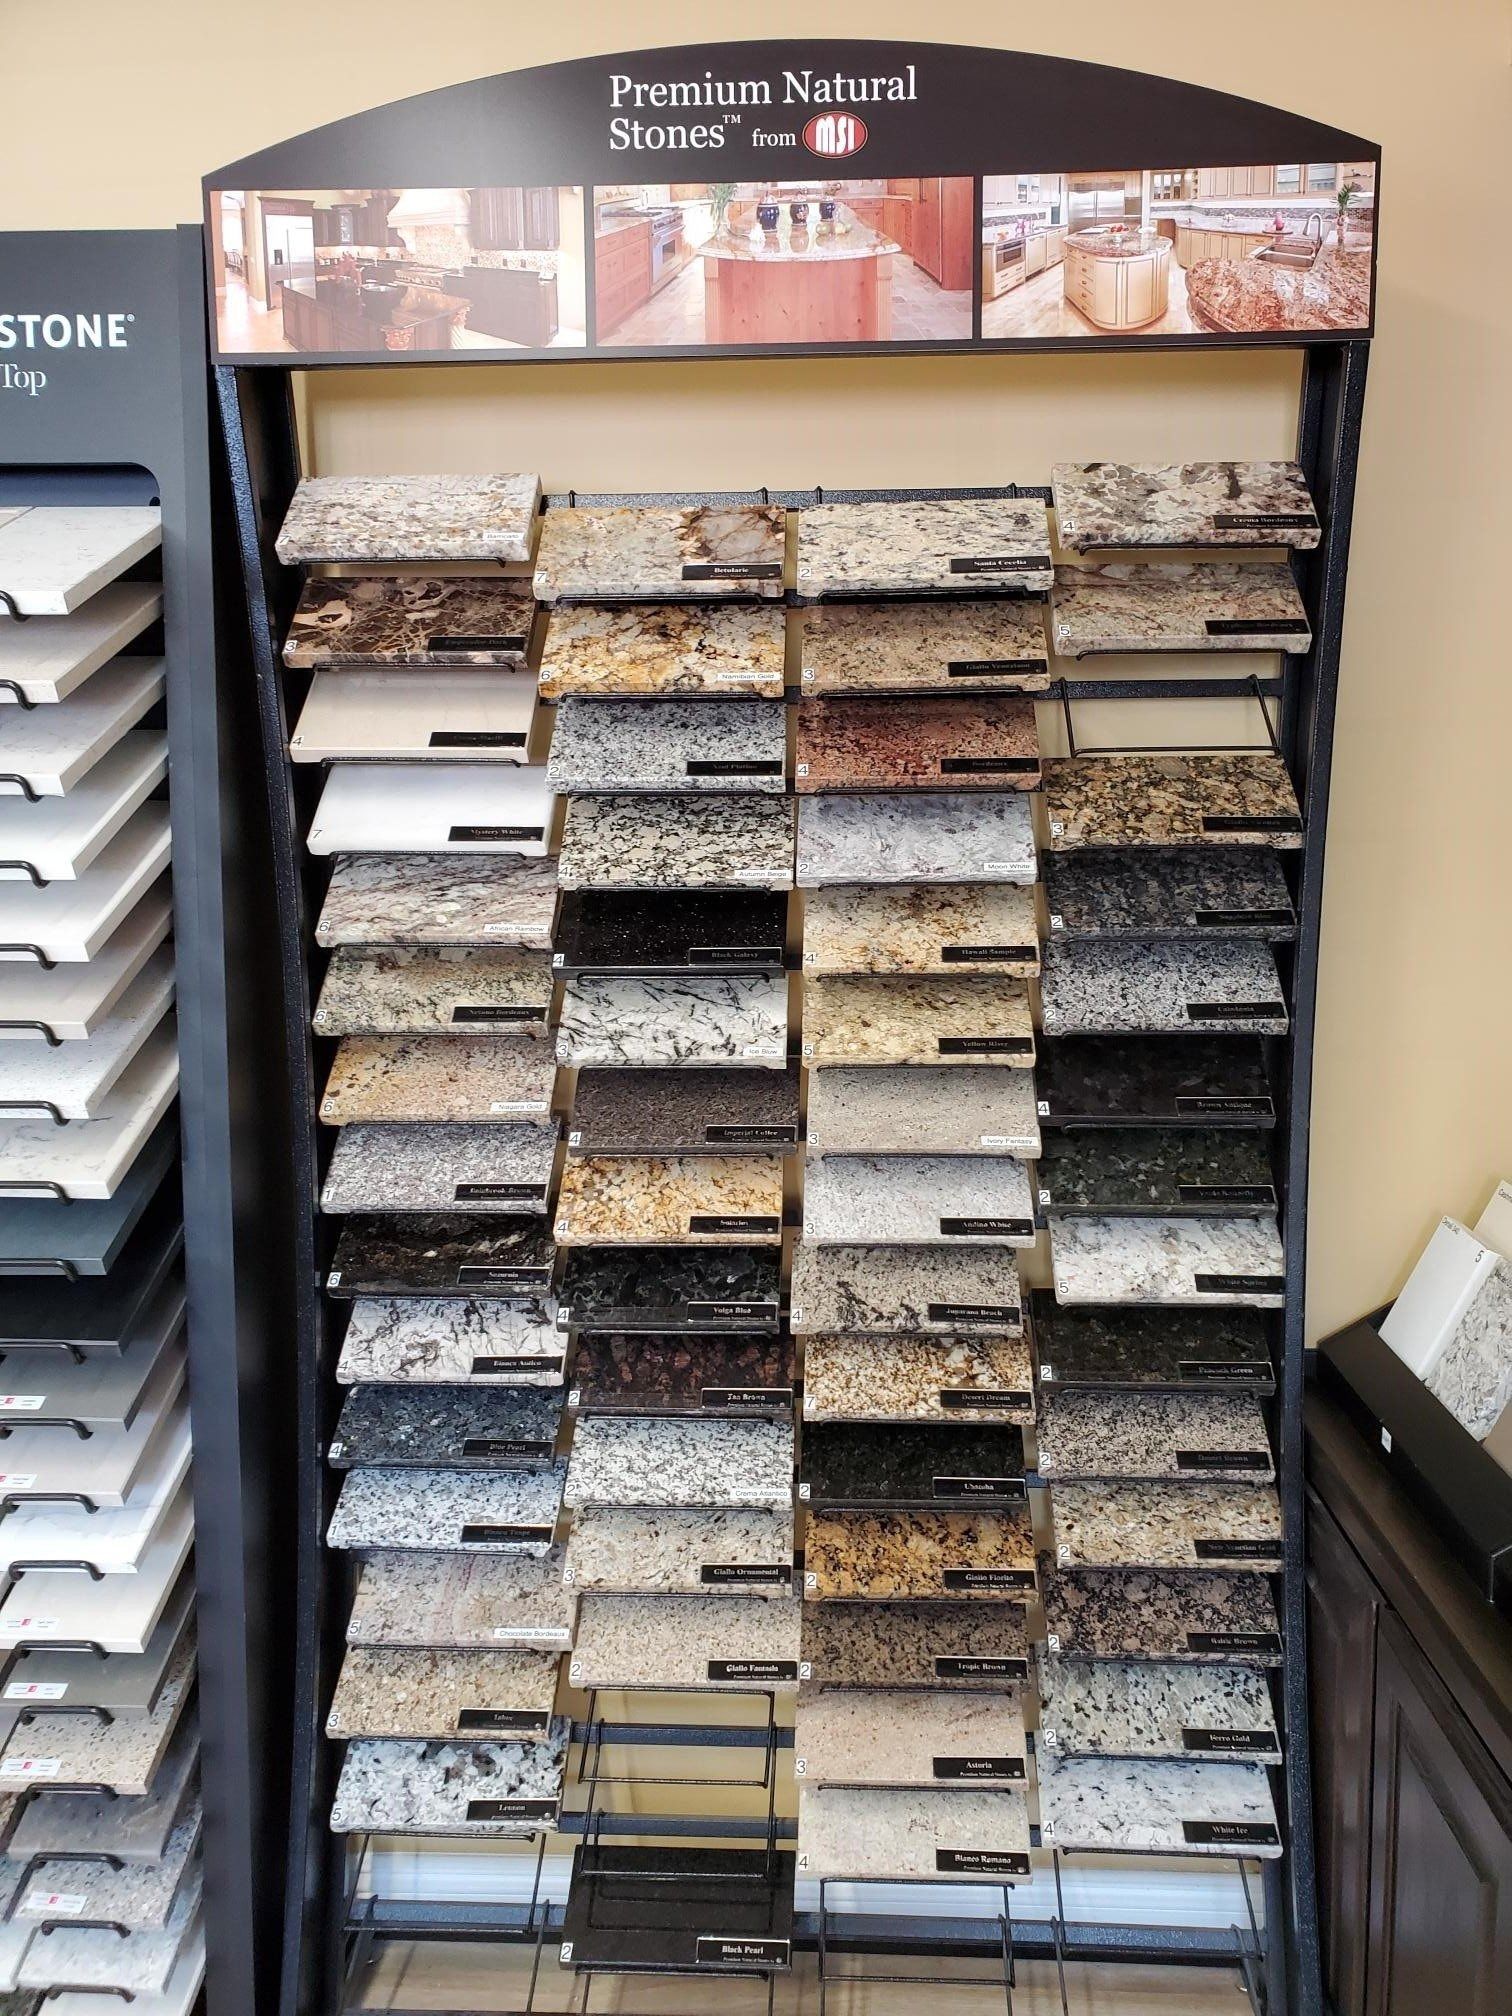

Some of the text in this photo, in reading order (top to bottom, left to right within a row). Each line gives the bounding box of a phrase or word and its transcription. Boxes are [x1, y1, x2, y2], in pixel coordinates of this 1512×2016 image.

[609, 65, 918, 107] Premium Natural
[751, 128, 797, 148] from
[815, 115, 855, 154] MSI
[0, 363, 47, 396] Top
[1063, 521, 1074, 530] 4
[278, 536, 288, 545] 7
[536, 572, 546, 581] 7
[800, 569, 810, 578] 2
[1059, 626, 1070, 635] 5
[285, 641, 295, 652] 3
[540, 670, 551, 680] 6
[803, 670, 814, 680] 3
[292, 736, 303, 746] 4
[549, 766, 560, 776] 2
[798, 765, 808, 775] 4
[311, 830, 322, 839] 7
[1053, 824, 1063, 834] 3
[560, 866, 569, 876] 4
[799, 864, 809, 874] 2
[319, 922, 329, 932] 6
[1052, 917, 1062, 927] 2
[553, 955, 563, 965] 4
[804, 954, 815, 963] 4
[315, 1011, 325, 1021] 6
[1046, 1010, 1055, 1021] 2
[557, 1044, 567, 1055] 3
[804, 1045, 813, 1055] 5
[323, 1102, 333, 1112] 6
[1038, 1103, 1048, 1113] 4
[569, 1134, 580, 1144] 4
[809, 1134, 818, 1144] 3
[987, 1137, 1004, 1145] Ivory
[1039, 1192, 1050, 1203] 2
[557, 1223, 567, 1234] 4
[806, 1223, 815, 1234] 3
[1475, 1250, 1485, 1263] 5
[329, 1274, 339, 1285] 6
[1059, 1282, 1069, 1293] 5
[557, 1310, 568, 1321] 4
[713, 1307, 734, 1315] Volga
[792, 1310, 802, 1321] 4
[338, 1361, 349, 1372] 4
[1041, 1367, 1051, 1379] 2
[569, 1393, 579, 1404] 2
[806, 1397, 815, 1408] 7
[331, 1445, 341, 1456] 4
[1040, 1454, 1050, 1466] 2
[566, 1485, 576, 1496] 2
[800, 1485, 810, 1497] 2
[1060, 1546, 1069, 1558] 2
[564, 1569, 574, 1582] 3
[807, 1575, 817, 1587] 2
[349, 1621, 360, 1633] 5
[499, 1630, 533, 1638] Chocolate
[1049, 1637, 1058, 1650] 2
[571, 1664, 582, 1677] 2
[801, 1665, 810, 1677] 2
[328, 1715, 339, 1727] 3
[1046, 1731, 1056, 1743] 2
[796, 1760, 806, 1774] 3
[965, 1761, 992, 1769] Astoria
[331, 1808, 342, 1821] 5
[1044, 1822, 1054, 1835] 4
[1212, 1826, 1234, 1834] White
[799, 1856, 809, 1869] 4
[562, 1946, 571, 1960] 2
[721, 1945, 743, 1954] Black
